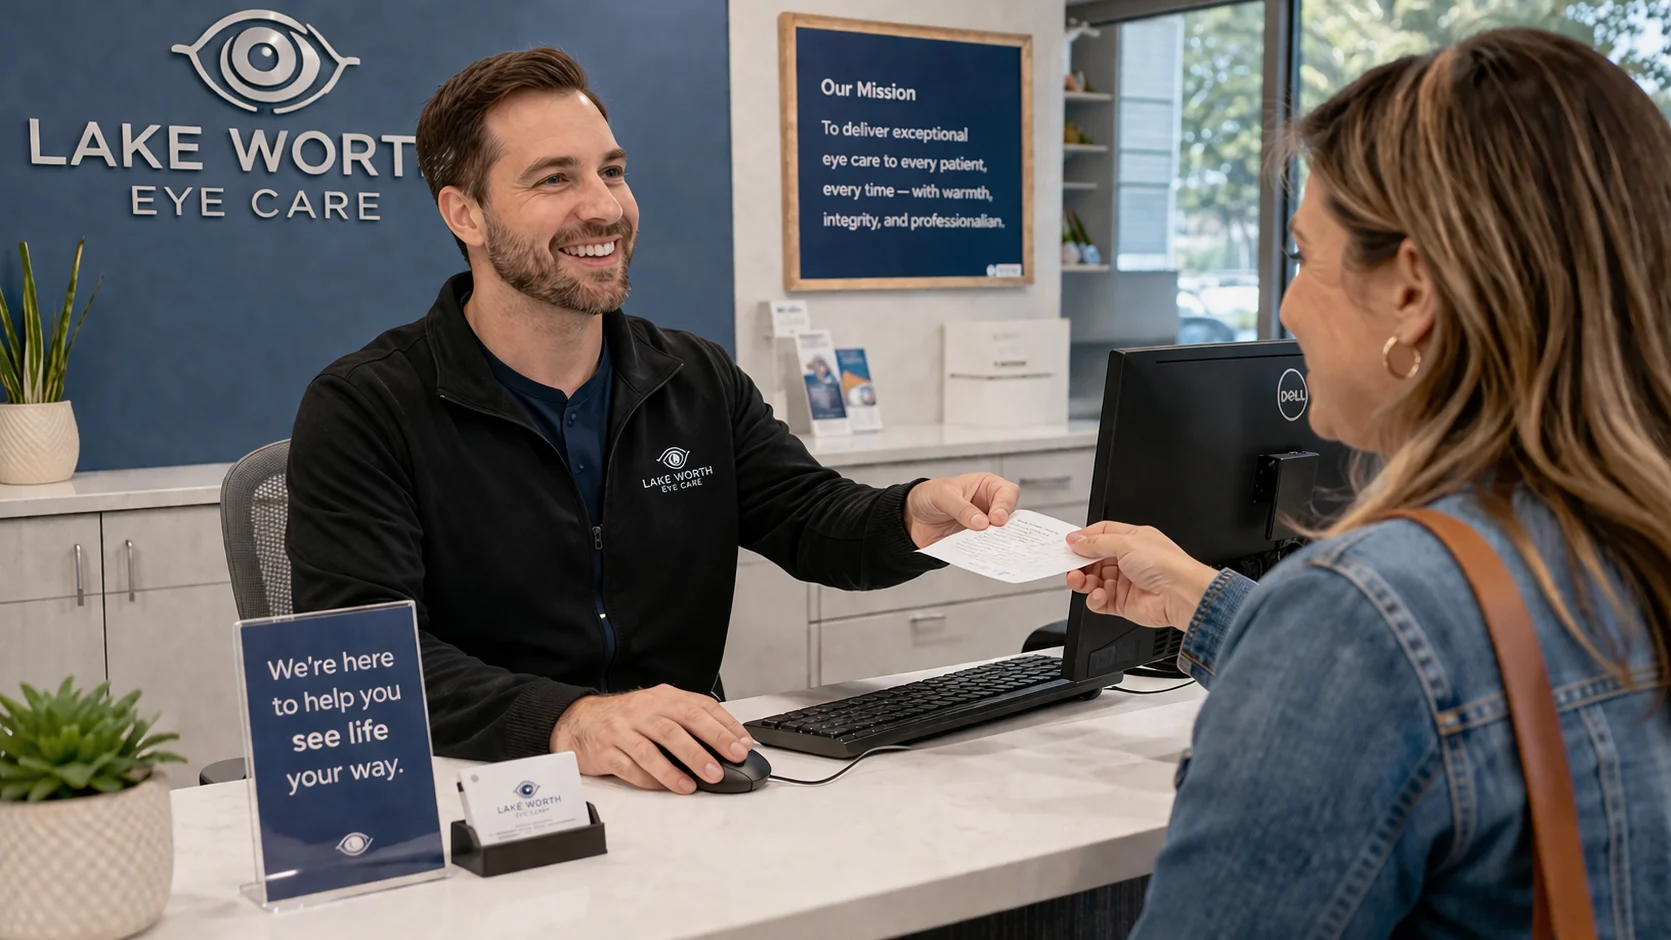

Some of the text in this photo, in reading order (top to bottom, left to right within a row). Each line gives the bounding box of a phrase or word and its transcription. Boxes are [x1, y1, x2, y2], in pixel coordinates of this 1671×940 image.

[821, 78, 916, 101] Our Mission
[821, 120, 968, 143] To deliver exceptional
[28, 117, 424, 178] LAKE WORT
[822, 154, 988, 174] eye care to every patient,
[131, 184, 381, 221] EYE CARE
[822, 184, 862, 201] every
[864, 182, 895, 198] time
[912, 184, 940, 199] with
[942, 186, 993, 202] warmth,
[822, 211, 882, 231] integrity,
[883, 212, 908, 228] and
[642, 465, 713, 489] LAKE WORTH
[661, 483, 678, 493] EYE
[267, 651, 395, 681] We're here
[272, 684, 402, 716] to help you
[292, 719, 389, 752] see life
[286, 758, 404, 796] your way.
[497, 802, 523, 815] LAKE
[525, 795, 562, 809] WORTH
